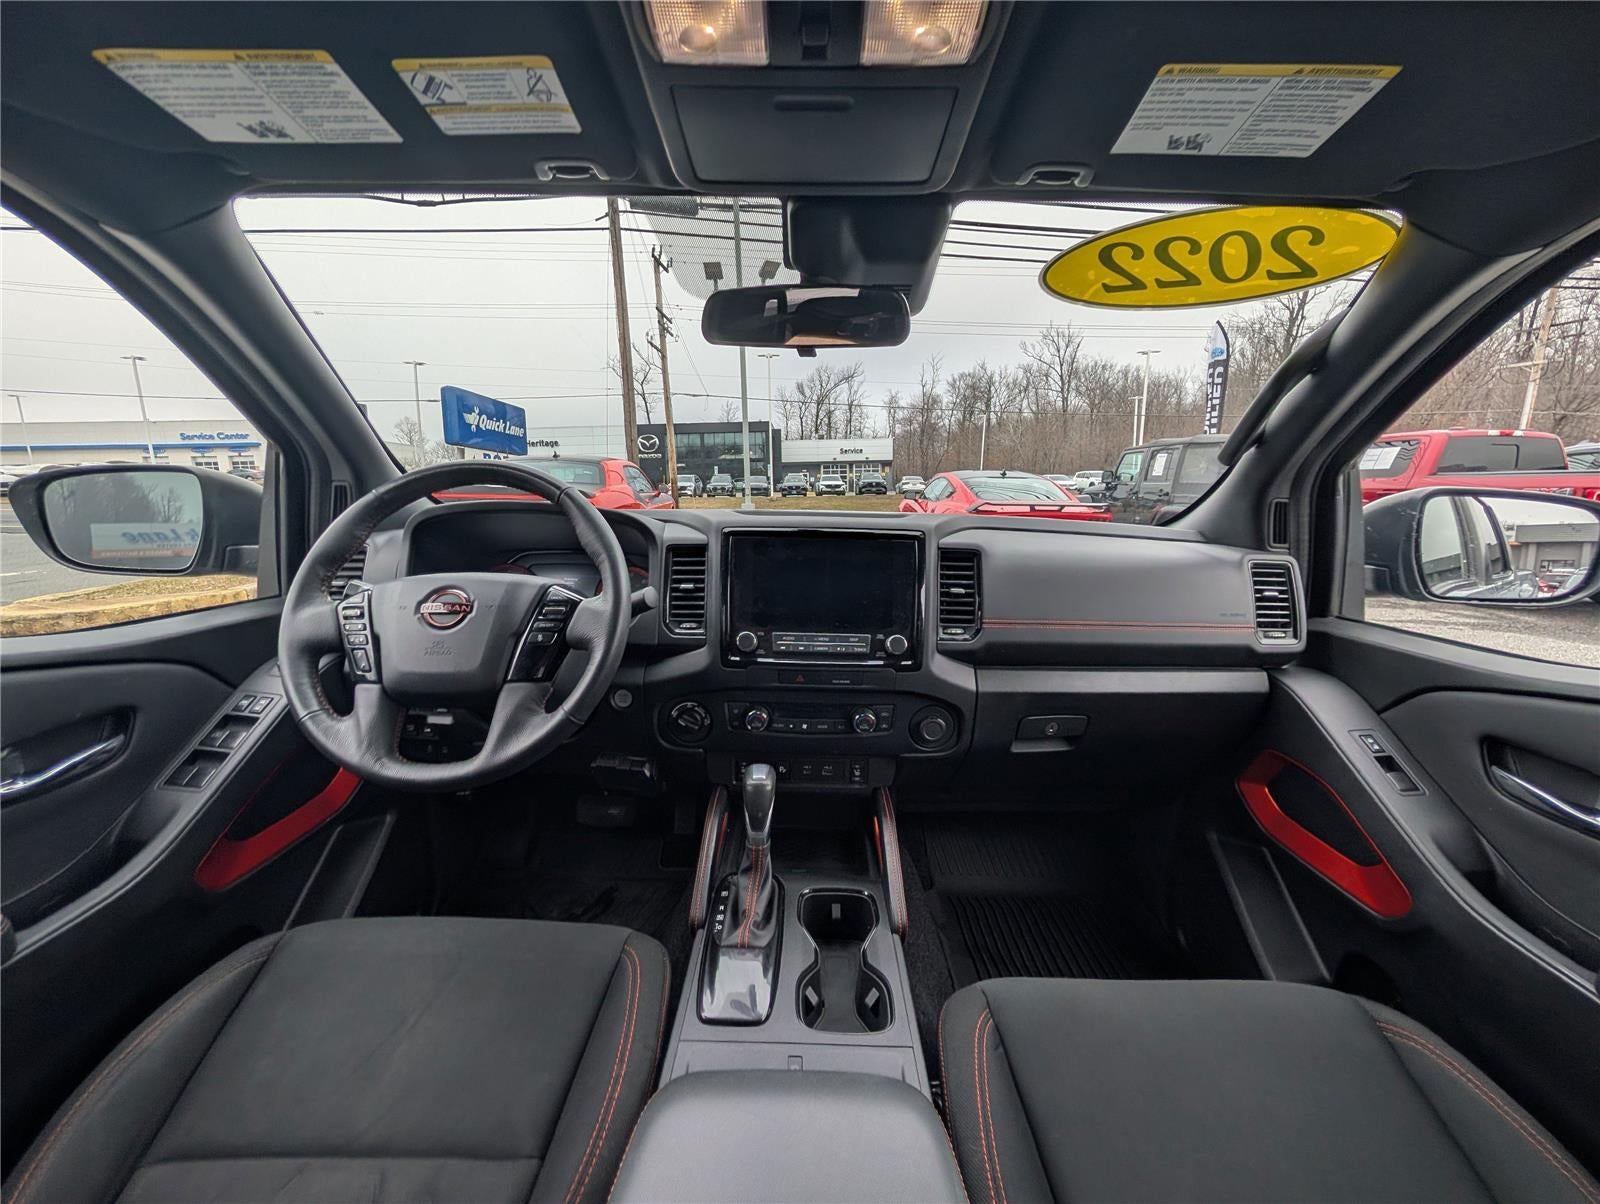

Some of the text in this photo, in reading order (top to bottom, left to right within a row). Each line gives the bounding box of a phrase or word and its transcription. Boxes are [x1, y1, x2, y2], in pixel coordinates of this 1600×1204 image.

[479, 414, 524, 437] Quick Lane
[179, 432, 249, 440] Service Center
[839, 447, 863, 455] Service
